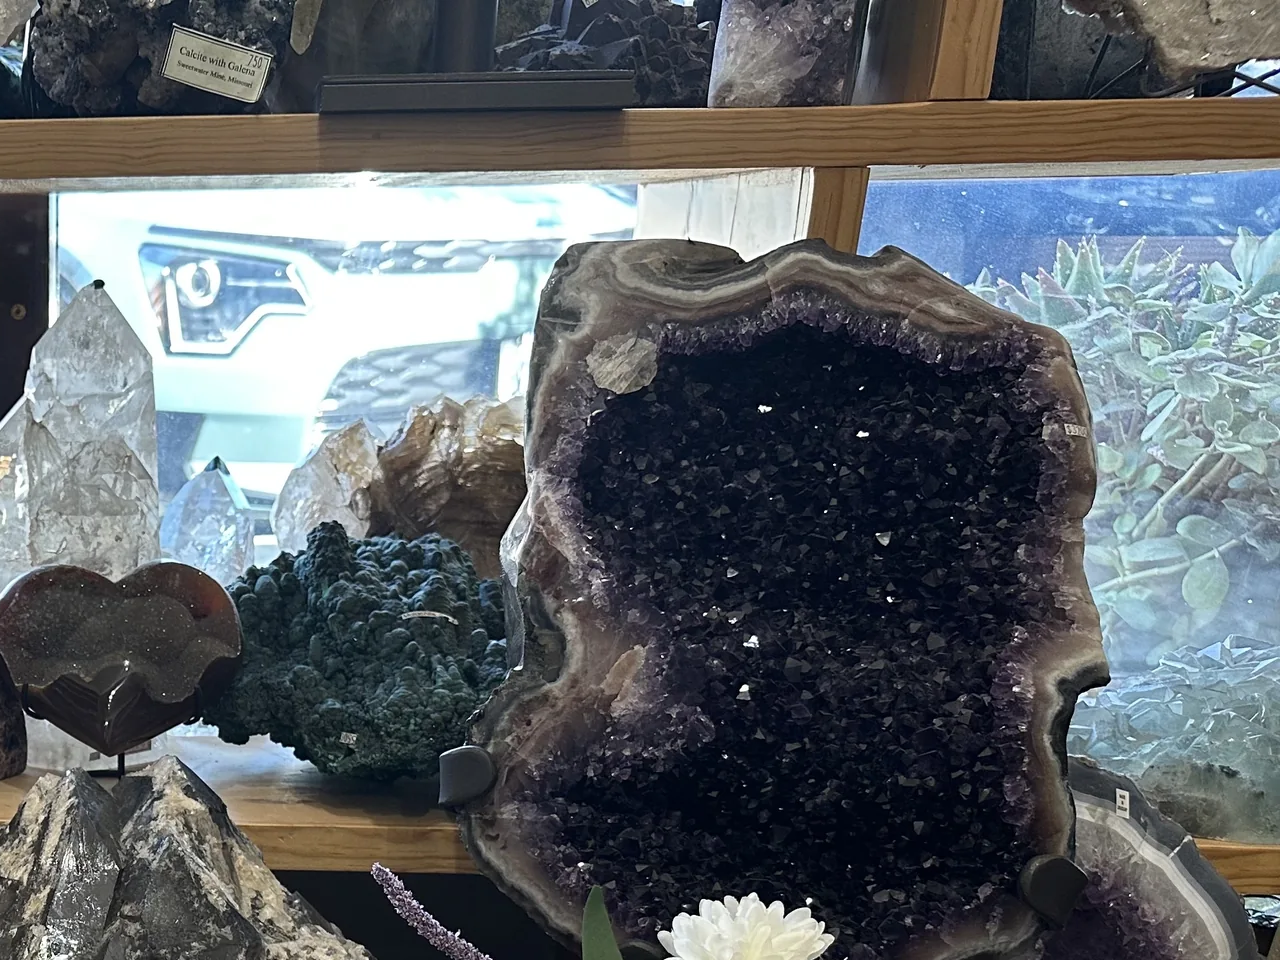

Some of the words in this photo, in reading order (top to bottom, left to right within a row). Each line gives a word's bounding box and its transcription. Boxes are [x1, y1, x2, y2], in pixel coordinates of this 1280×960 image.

[176, 60, 209, 76] Sweetwater
[209, 69, 227, 82] Mine,
[227, 75, 254, 89] Missouri
[179, 46, 207, 63] Calcite
[208, 56, 227, 69] with
[227, 63, 256, 77] Galena
[247, 54, 263, 69] 750
